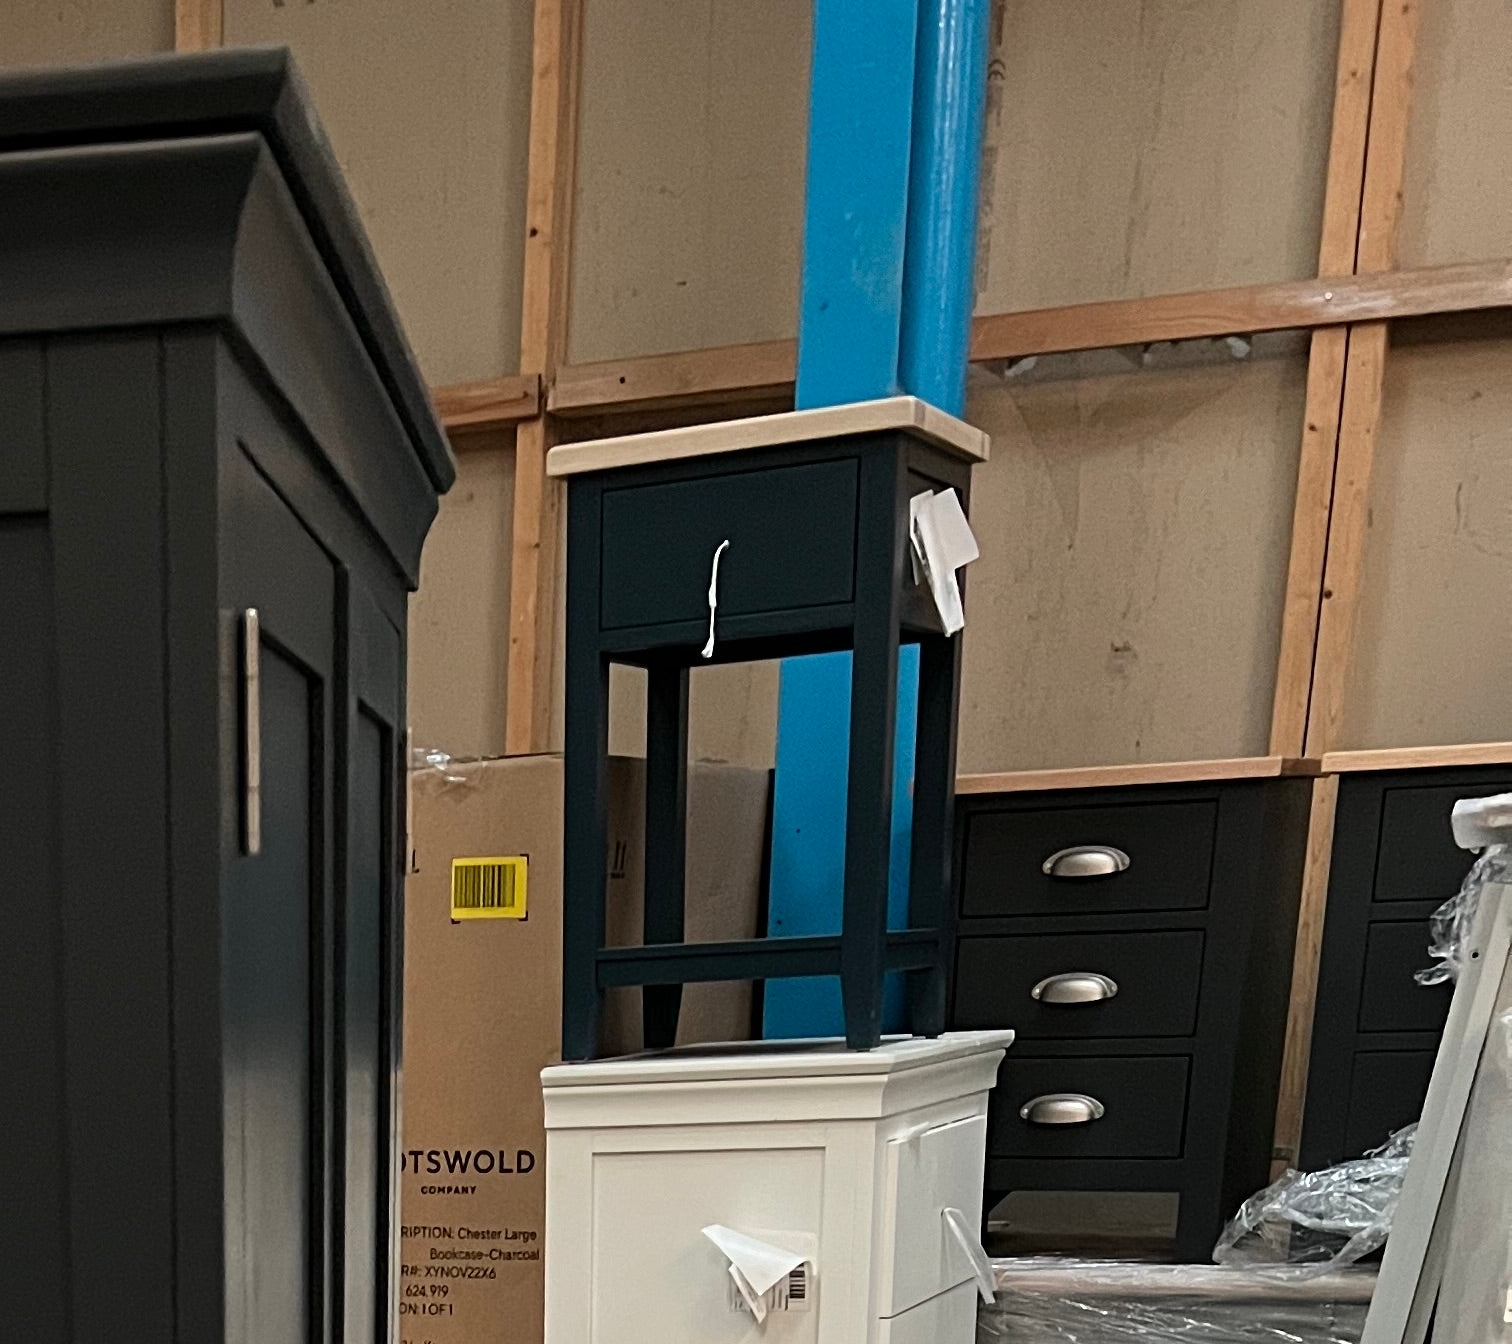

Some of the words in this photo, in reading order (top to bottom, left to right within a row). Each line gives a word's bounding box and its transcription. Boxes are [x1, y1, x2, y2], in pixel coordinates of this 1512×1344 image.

[401, 1150, 535, 1174] TSWOLD
[420, 1185, 477, 1195] COMPANY
[457, 1227, 502, 1241] Chester
[504, 1228, 537, 1243] Large
[430, 1247, 539, 1261] Bookcase-Charcoal
